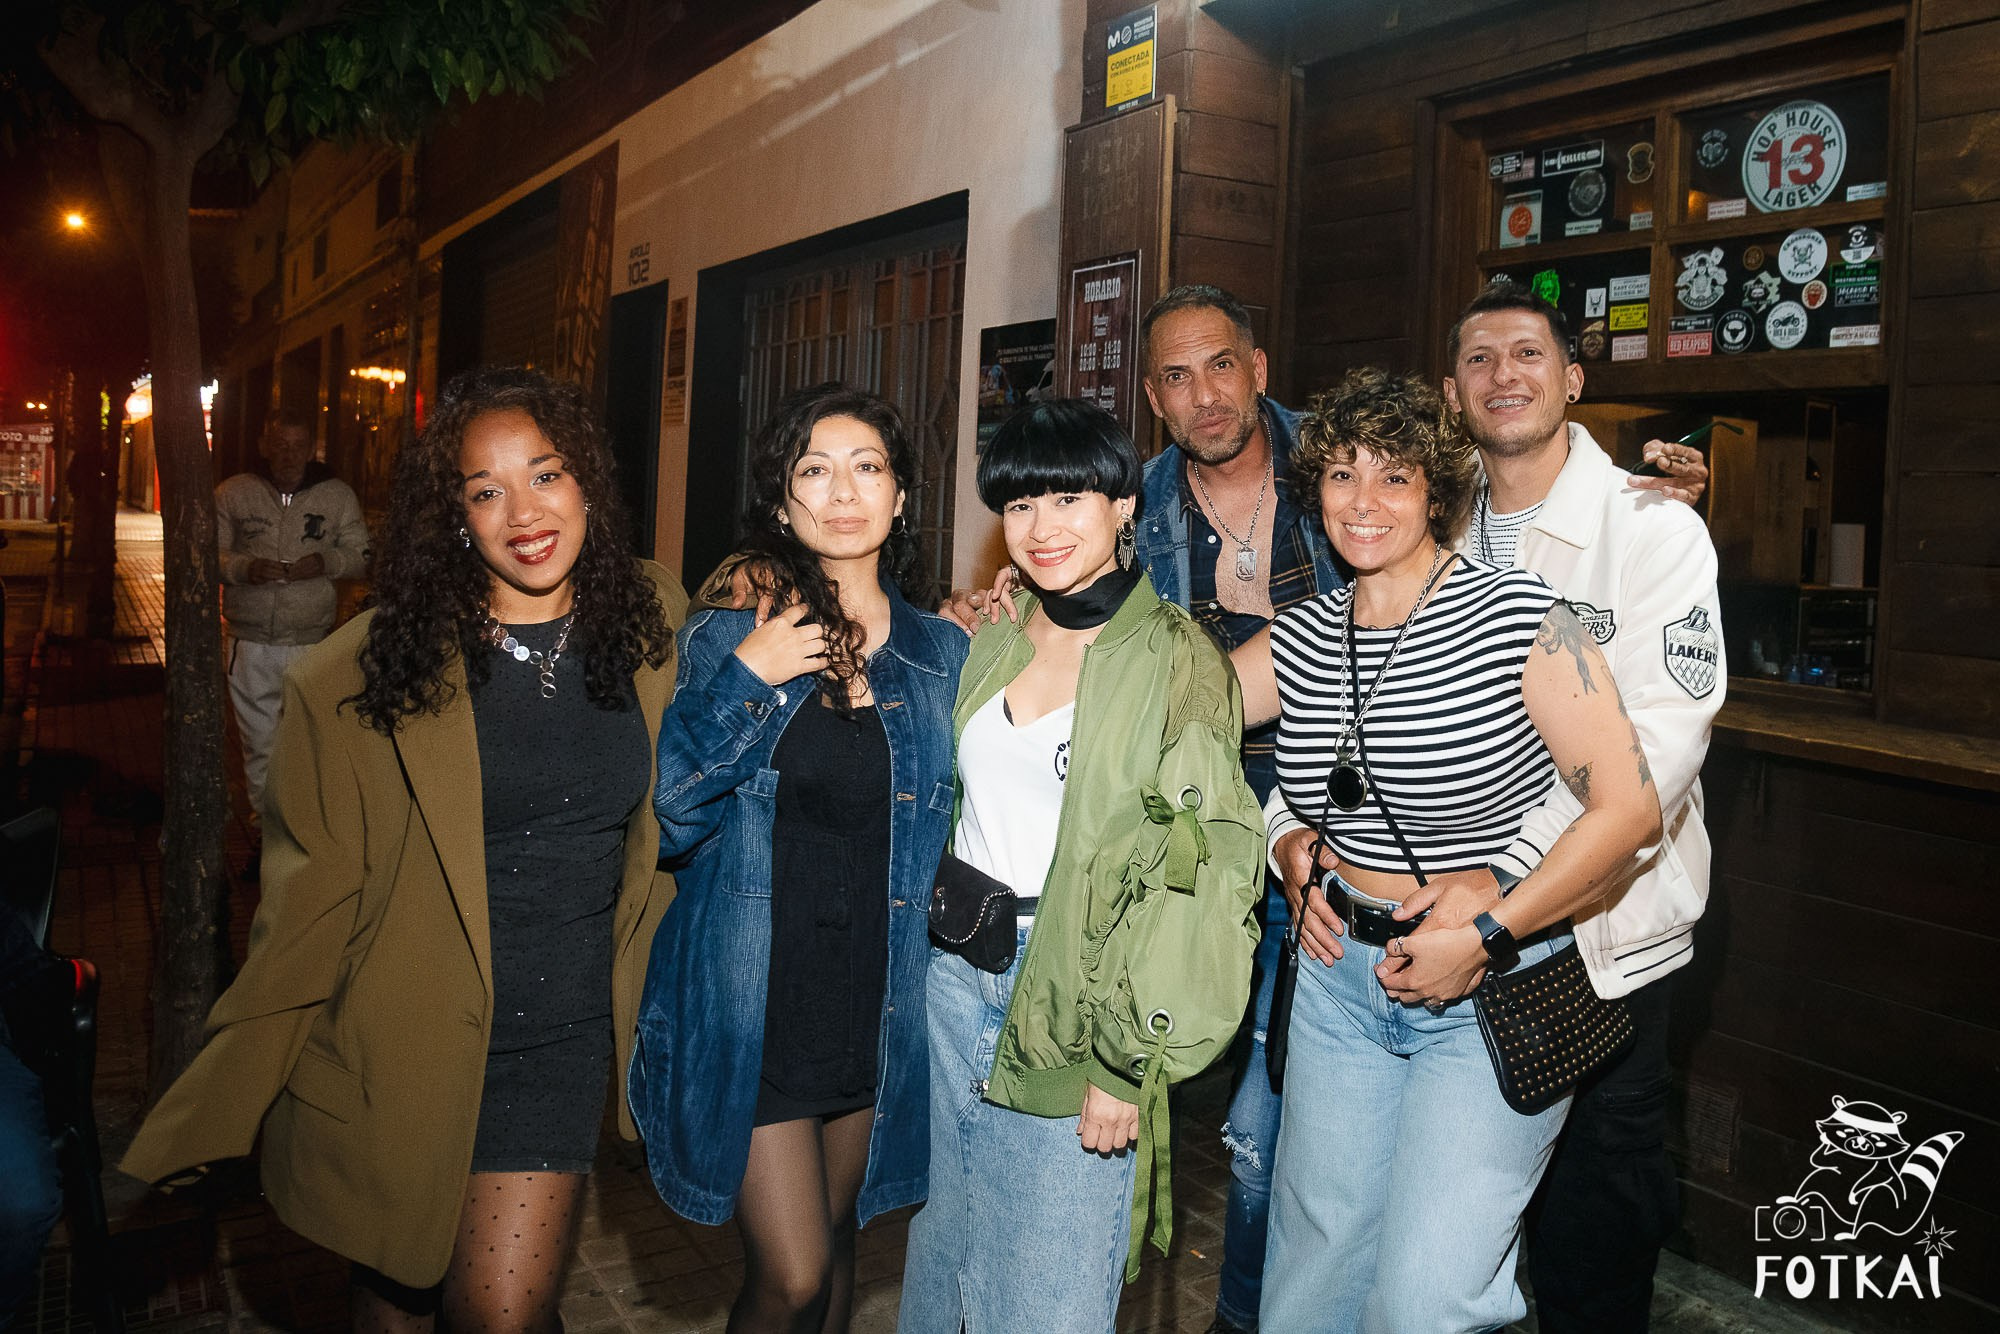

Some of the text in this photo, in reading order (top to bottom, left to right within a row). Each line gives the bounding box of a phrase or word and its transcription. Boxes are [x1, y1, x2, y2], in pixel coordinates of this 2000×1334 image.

[1111, 50, 1150, 71] CONECTADA
[1751, 122, 1778, 162] HOP
[1786, 110, 1837, 151] HOUSE
[1561, 151, 1586, 164] KILLER
[1757, 133, 1825, 189] 13
[1763, 181, 1822, 208] LAGER
[628, 259, 650, 286] 102
[1084, 277, 1120, 303] HORARIO
[1669, 340, 1682, 352] RED
[1581, 613, 1609, 622] ANGELES
[1668, 642, 1718, 667] LAKERS
